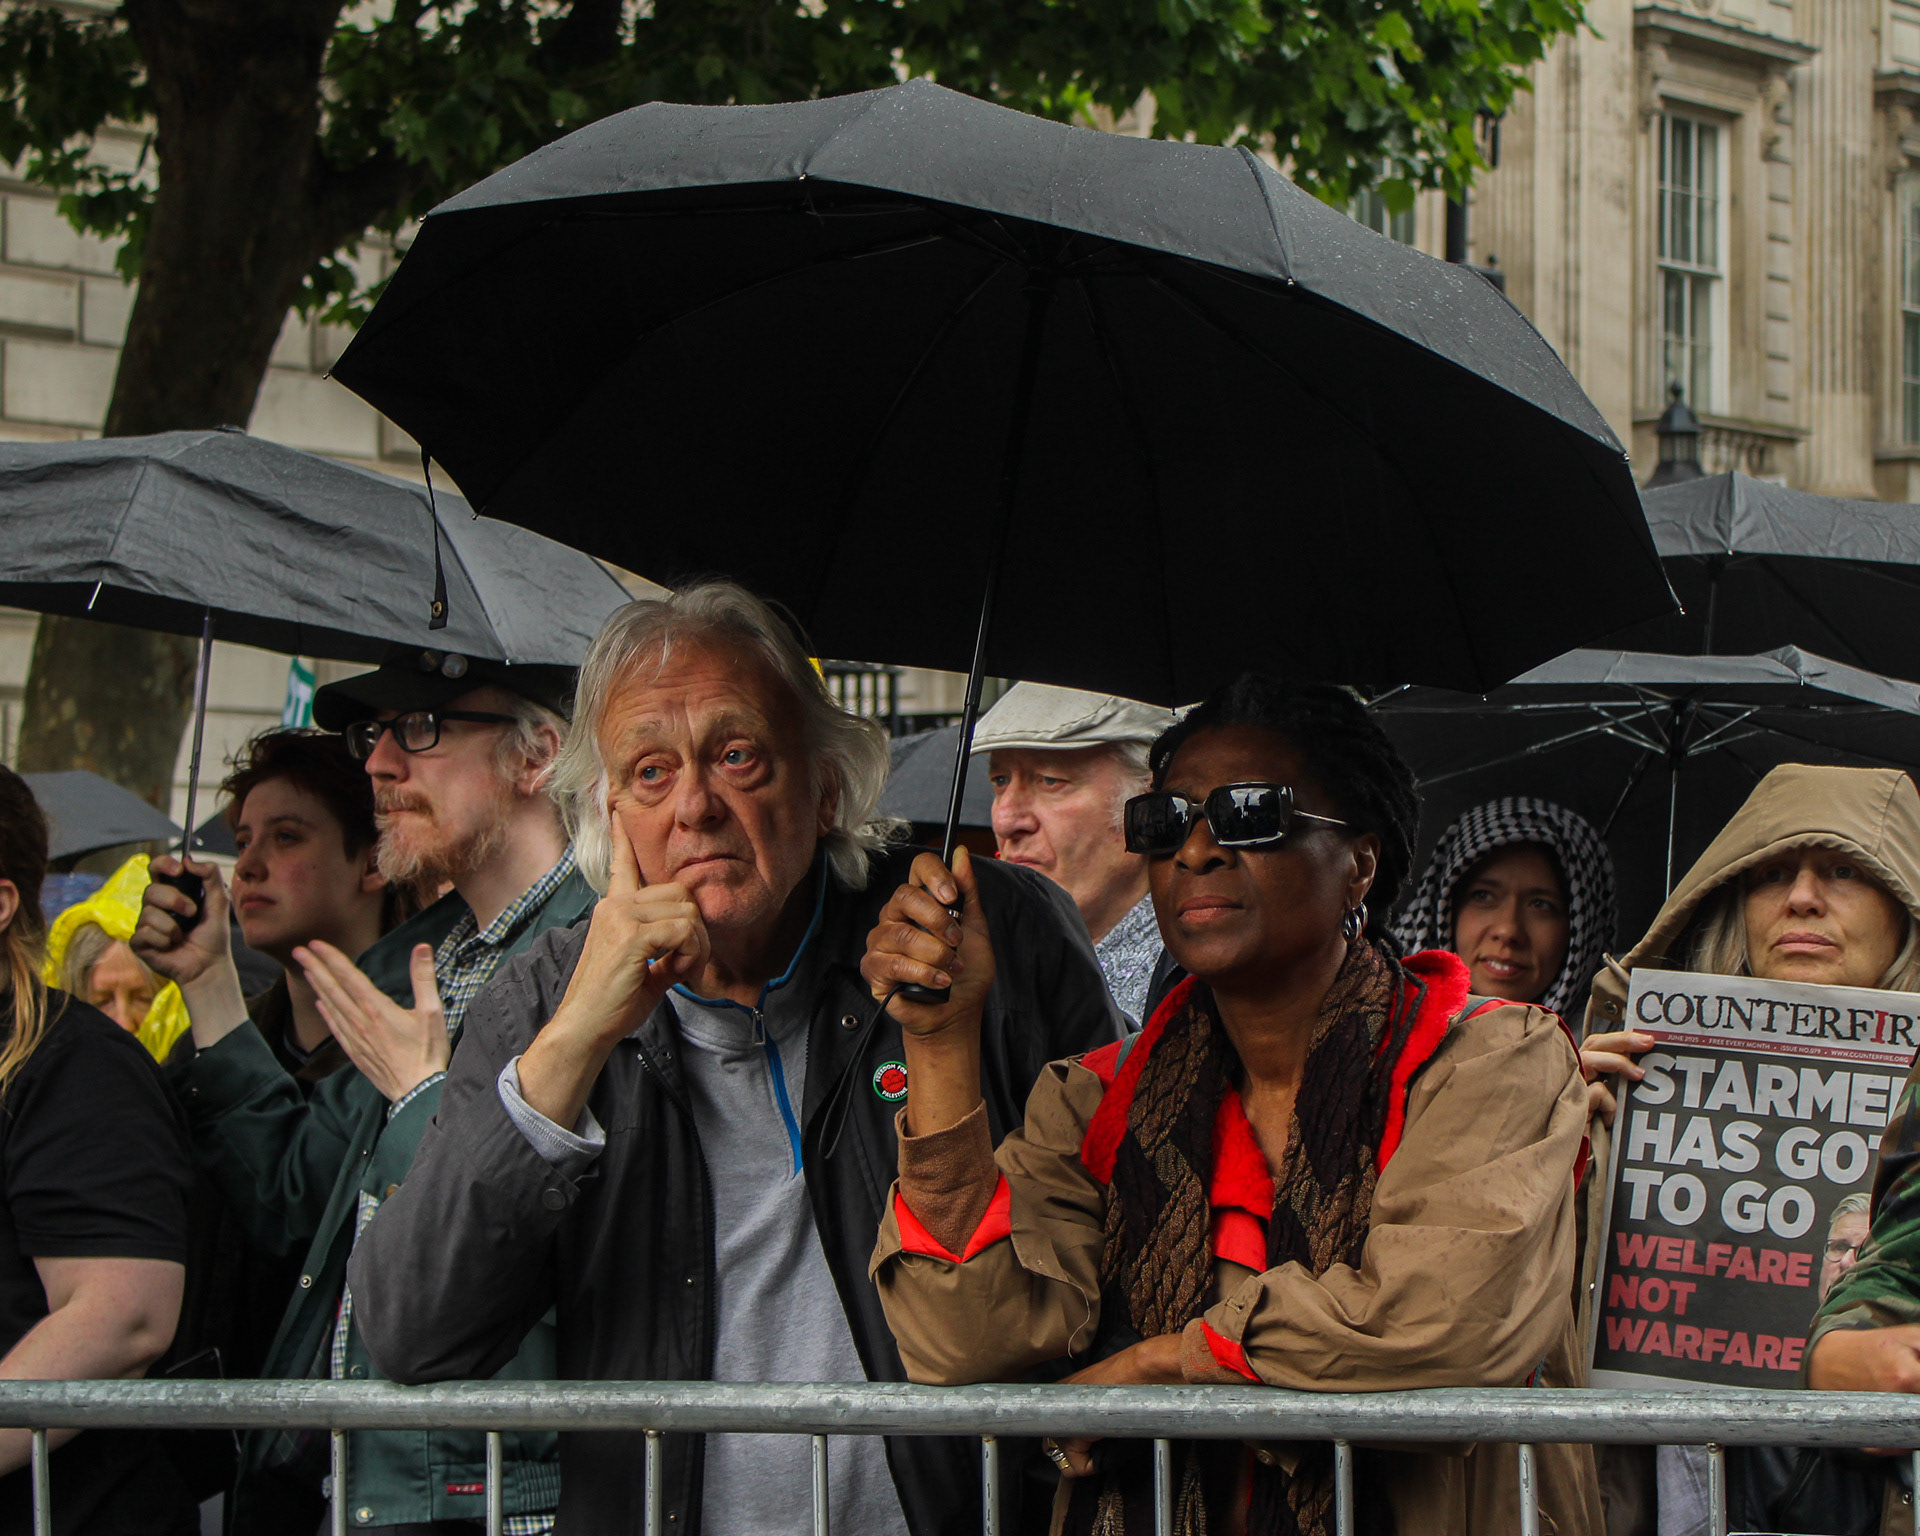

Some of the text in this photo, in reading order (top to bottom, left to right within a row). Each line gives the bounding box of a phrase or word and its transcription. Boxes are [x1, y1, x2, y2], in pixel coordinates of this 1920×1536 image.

[1636, 990, 1920, 1047] COUNTERFIR
[875, 1064, 896, 1082] FREEDOM
[1725, 1039, 1746, 1047] EVERY
[1746, 1041, 1770, 1049] MONTH
[1780, 1044, 1798, 1053] ISSUE
[1831, 1050, 1909, 1063] WWW.COUNTERFIRE.ORG
[1627, 1110, 1882, 1185] HAS GO
[1622, 1168, 1816, 1239] TO GO
[1616, 1232, 1813, 1287] WELFARE
[1608, 1274, 1697, 1315] NOT
[1605, 1316, 1806, 1371] WARFARE
